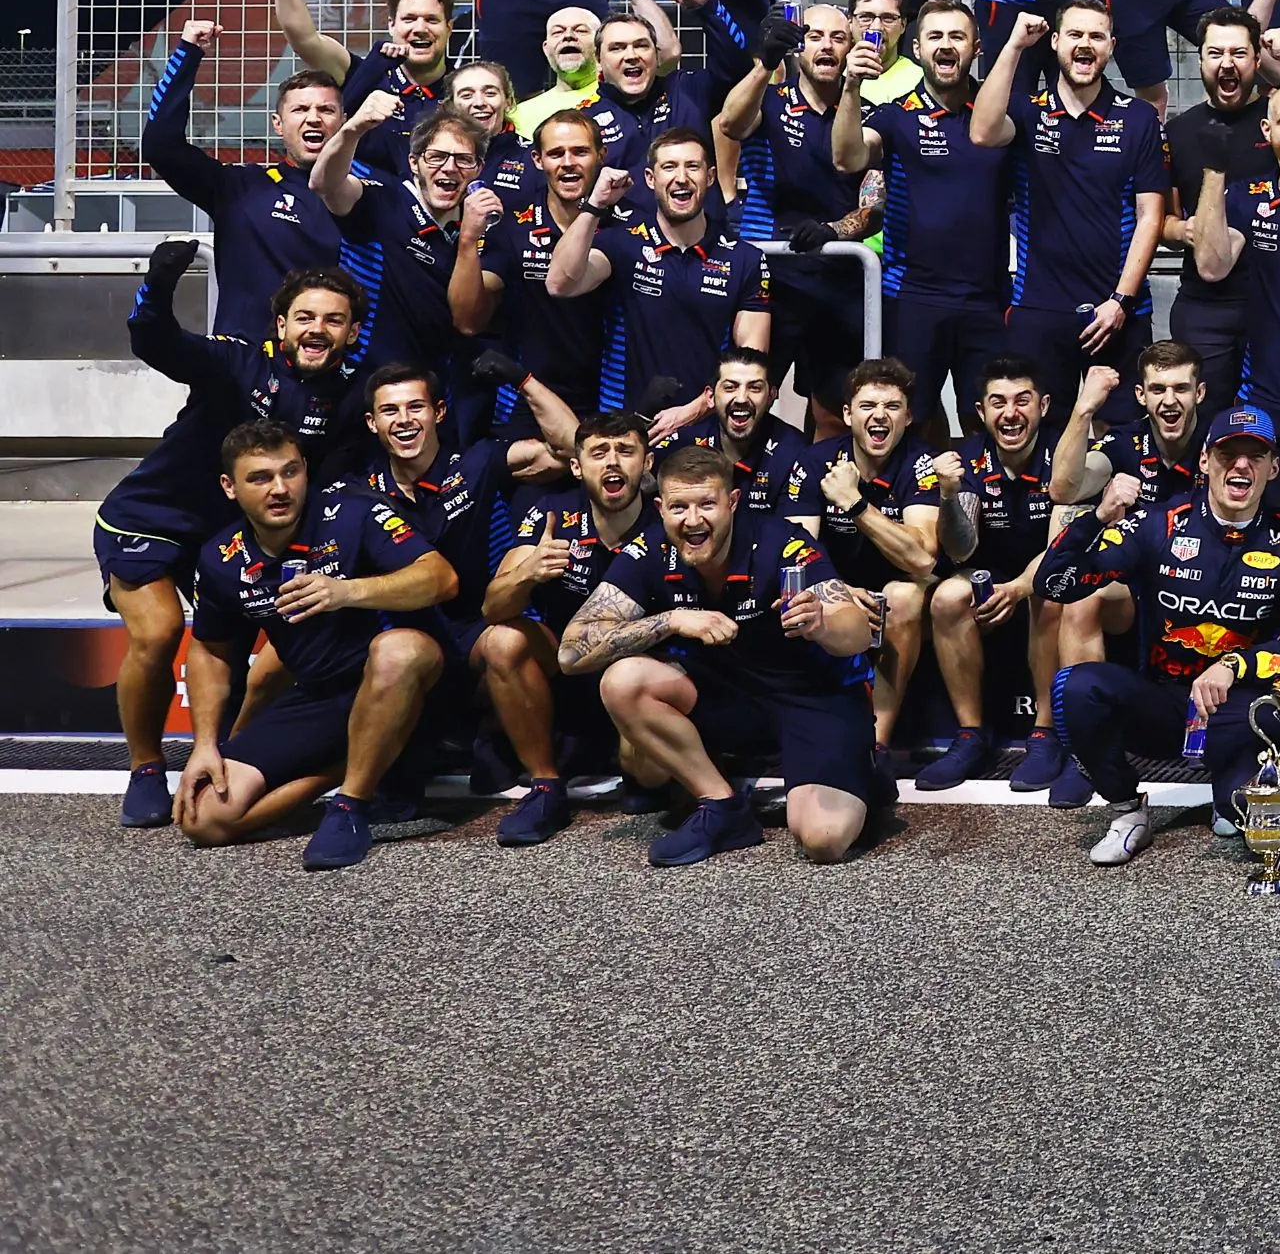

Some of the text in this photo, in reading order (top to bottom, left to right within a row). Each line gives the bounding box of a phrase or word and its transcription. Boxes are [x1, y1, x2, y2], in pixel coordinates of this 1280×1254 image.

[1097, 136, 1120, 144] BYBIT
[704, 275, 727, 286] BYBIT
[444, 490, 469, 511] BYBIT
[447, 502, 474, 520] HONDA
[1175, 539, 1198, 549] TAG
[1253, 555, 1277, 565] RAUCH
[1160, 565, 1189, 579] Mobil
[1241, 576, 1278, 589] BYBIT
[1237, 591, 1274, 599] HONDA
[1158, 591, 1274, 621] ORACLE
